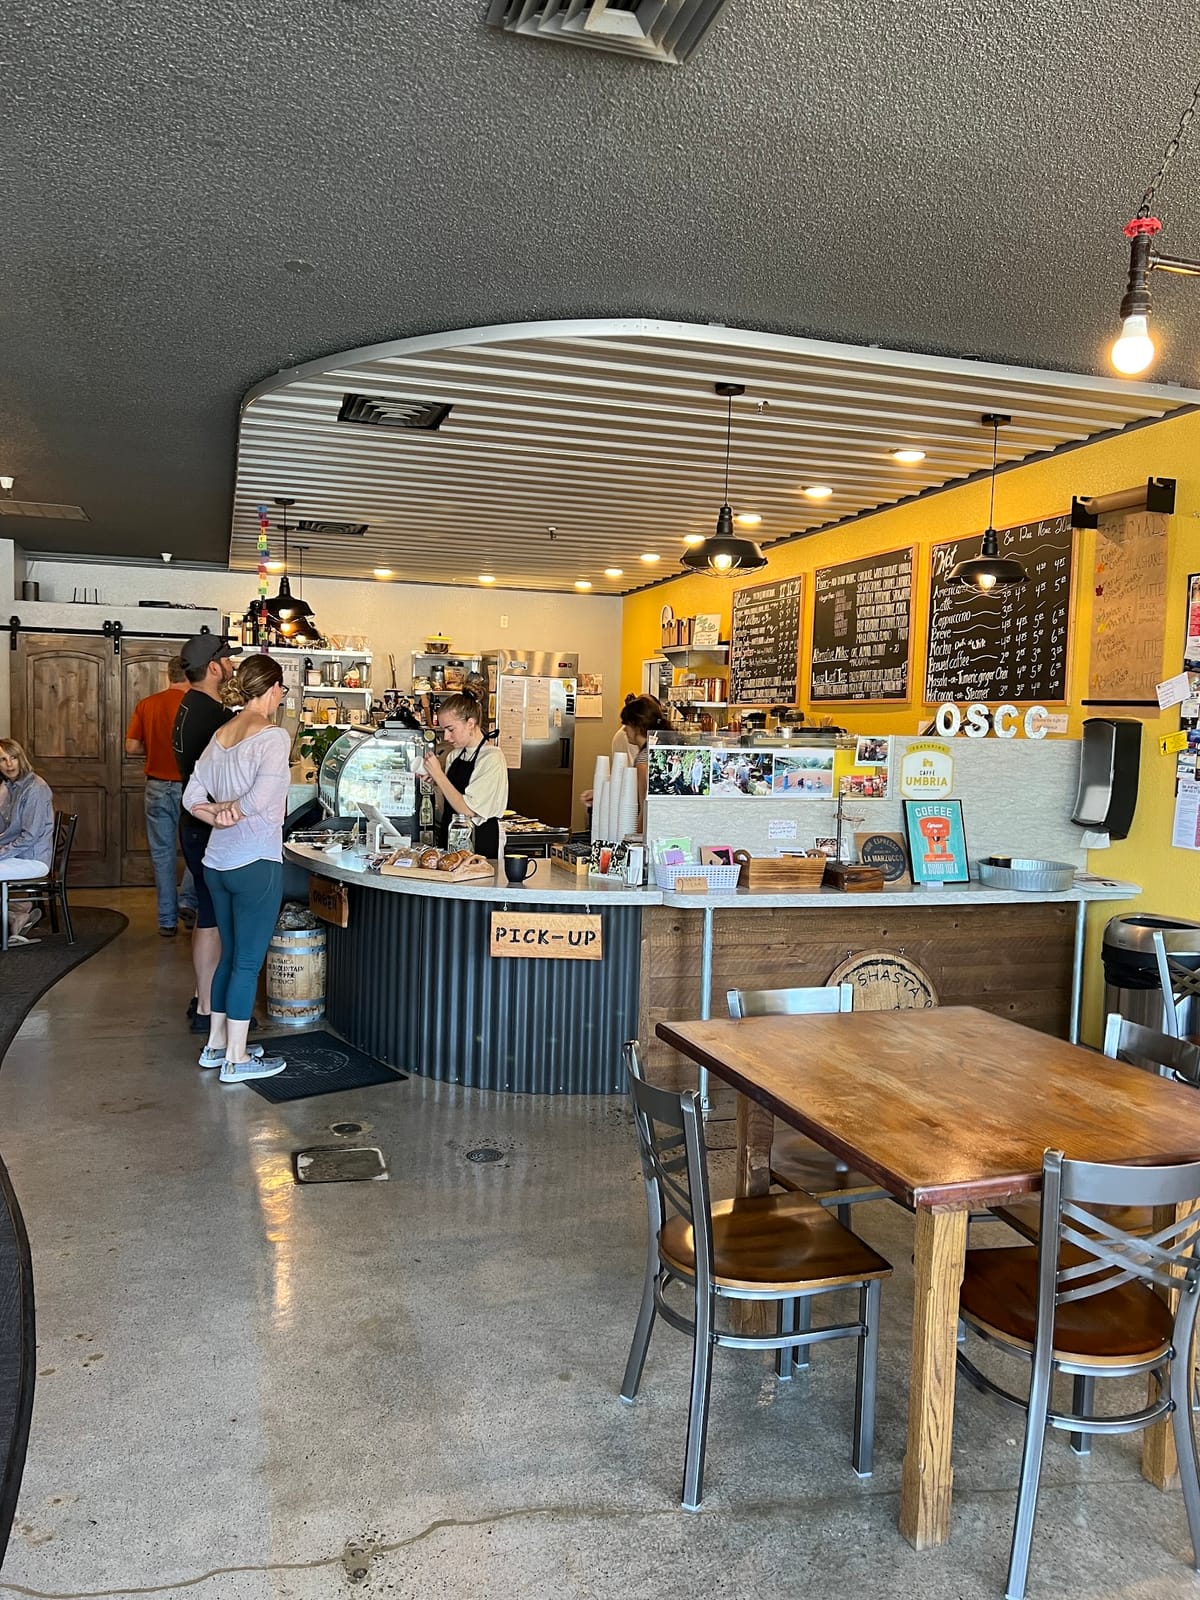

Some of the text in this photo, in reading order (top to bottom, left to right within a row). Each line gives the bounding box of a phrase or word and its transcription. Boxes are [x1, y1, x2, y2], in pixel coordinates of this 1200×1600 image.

[935, 544, 958, 576] Hot
[932, 611, 971, 629] Cappuccino
[931, 628, 952, 641] Breve
[929, 641, 952, 656] Mocha
[949, 651, 970, 669] coffee
[935, 702, 1048, 739] OSCC
[905, 776, 948, 786] UMBRIA
[914, 806, 953, 817] COFFEE
[864, 855, 872, 863] LA
[922, 863, 927, 874] A
[495, 926, 596, 946] PICK-UP
[857, 969, 921, 1000] SHASTA
